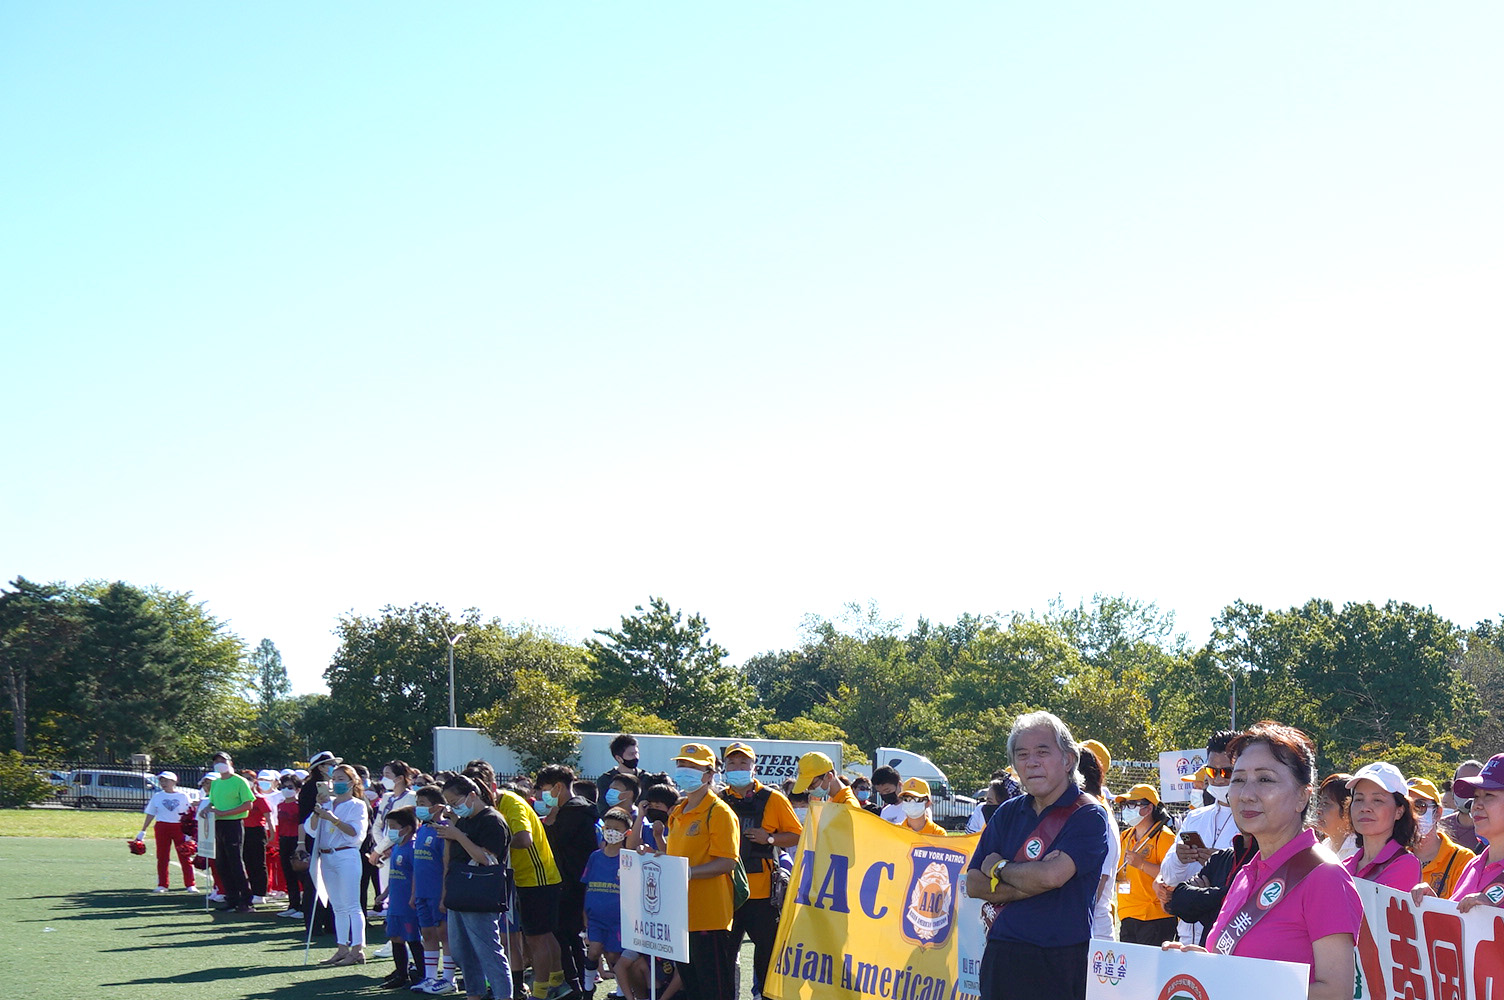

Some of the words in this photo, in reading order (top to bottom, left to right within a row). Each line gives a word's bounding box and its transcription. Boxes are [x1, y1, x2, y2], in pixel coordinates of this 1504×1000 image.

[913, 848, 928, 859] NEW
[928, 850, 944, 861] YORK
[944, 854, 965, 864] PATROL
[919, 891, 943, 914] AAC
[774, 940, 833, 986] Asian
